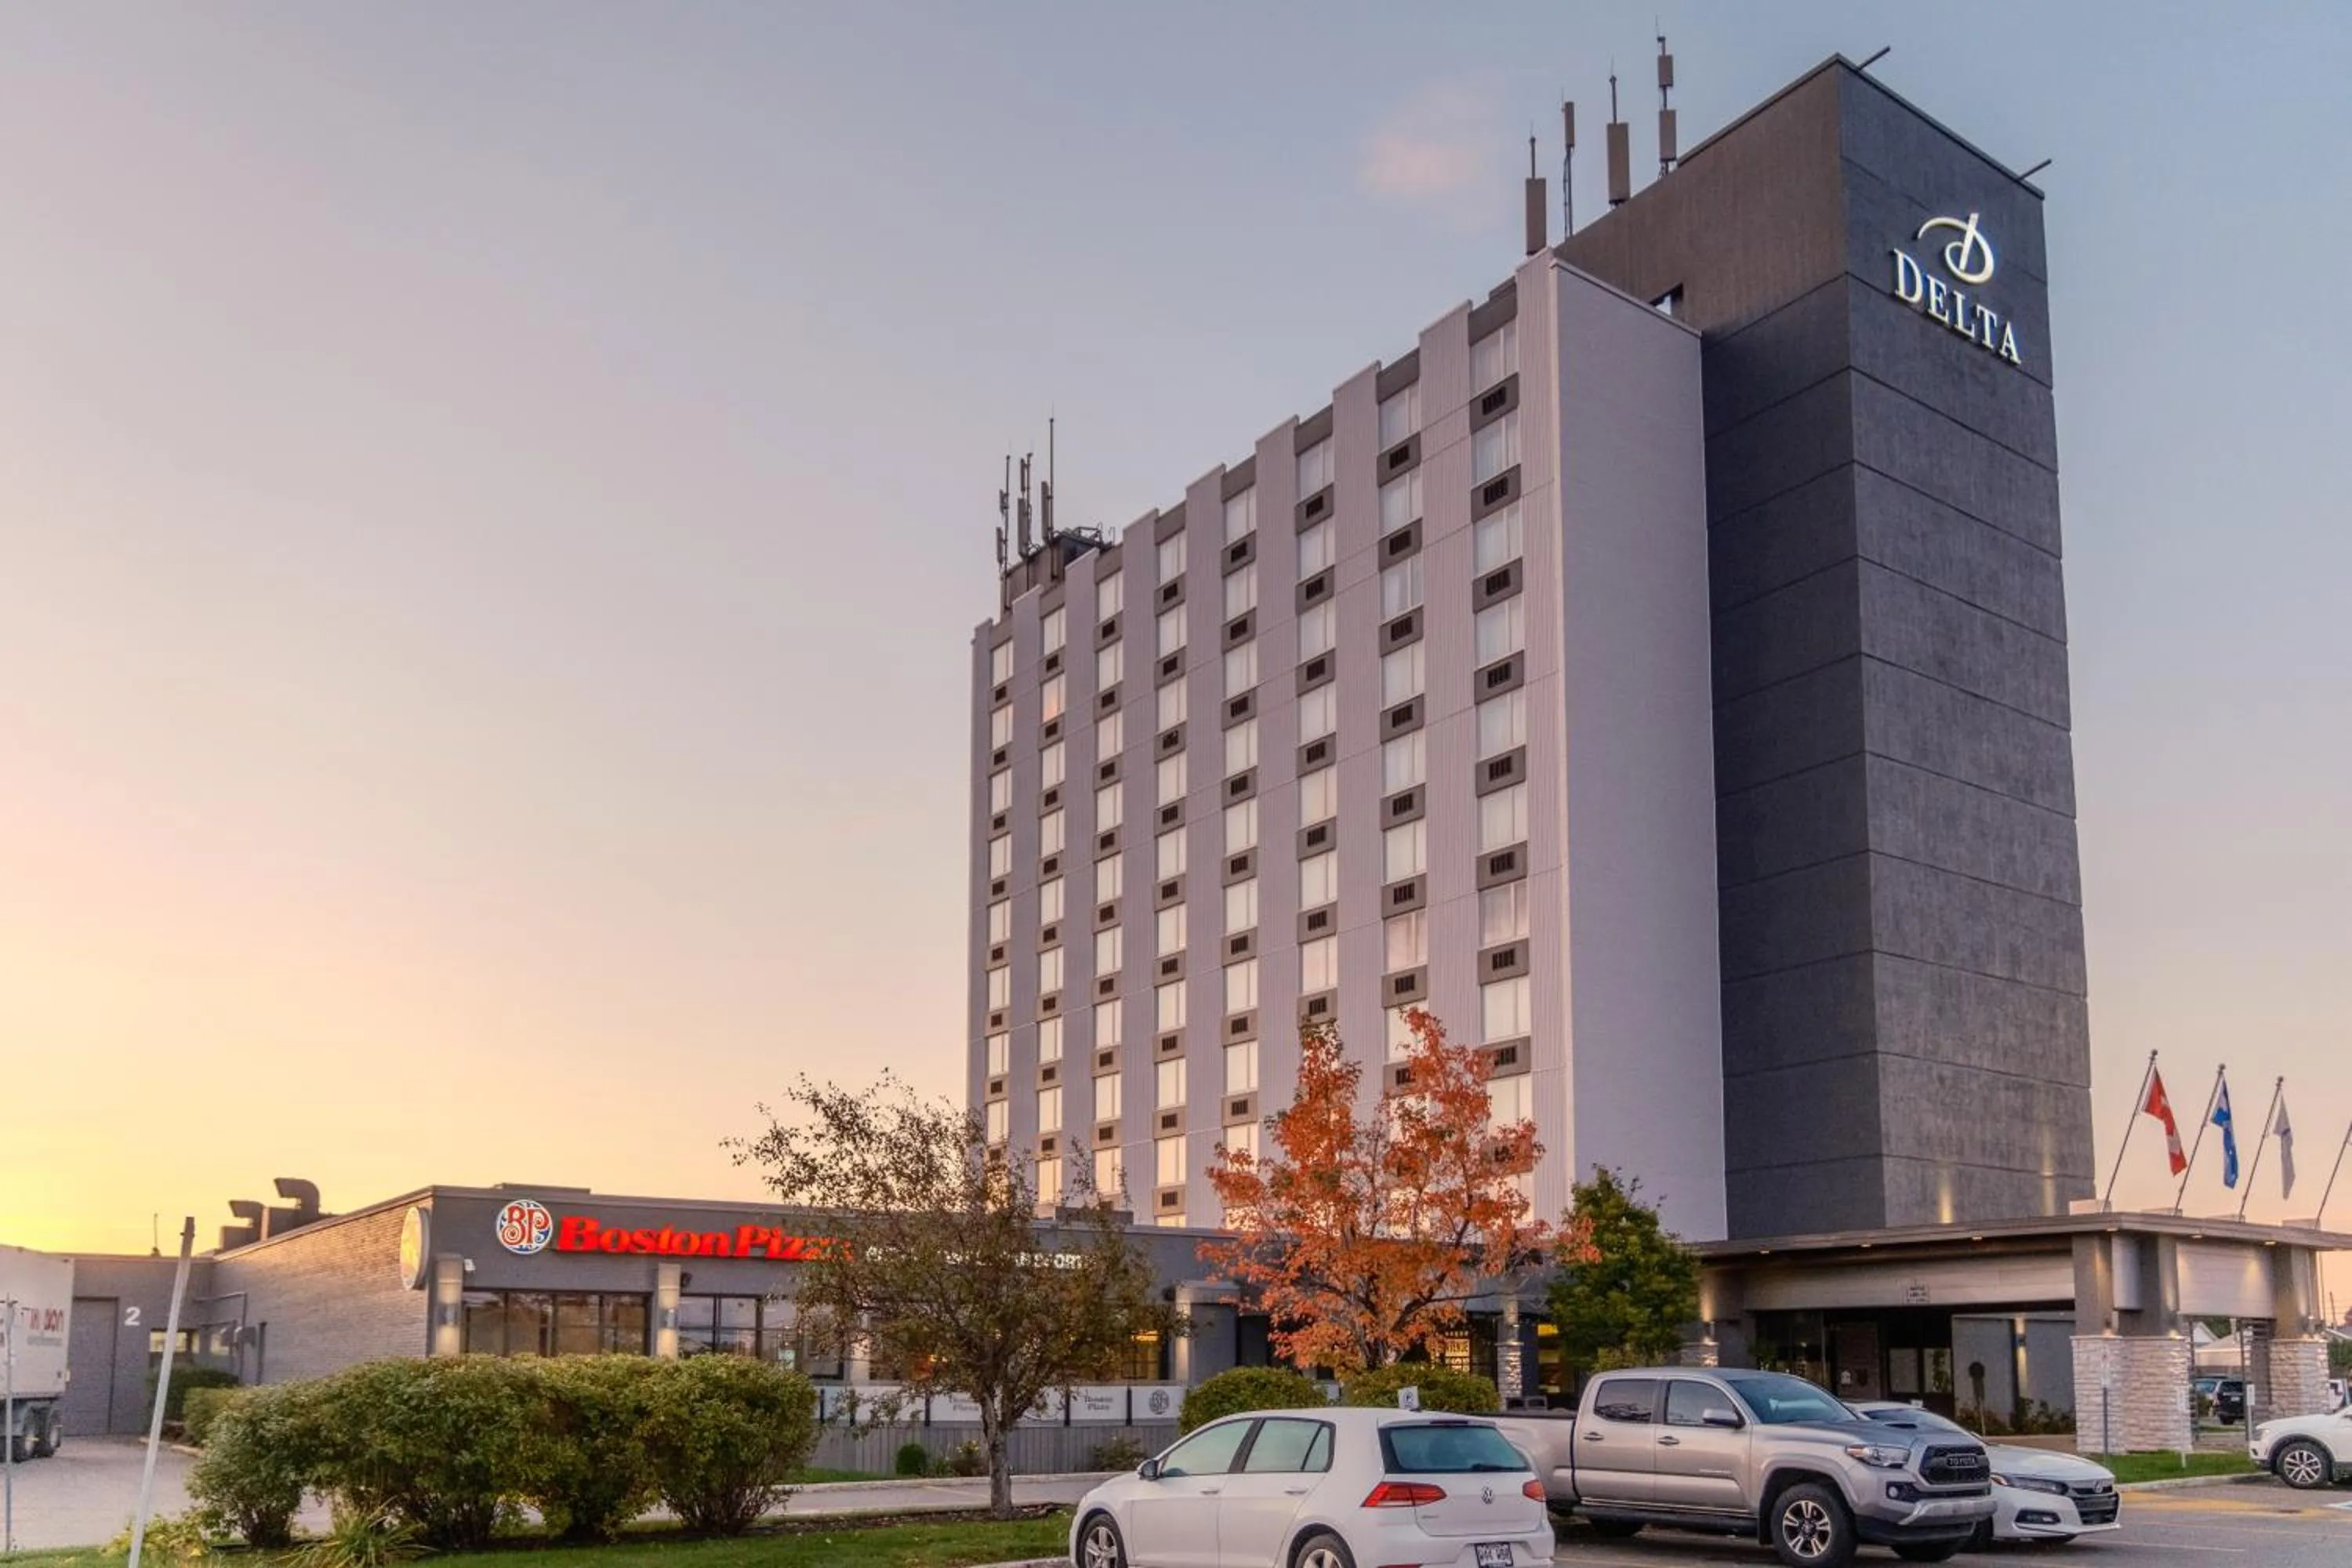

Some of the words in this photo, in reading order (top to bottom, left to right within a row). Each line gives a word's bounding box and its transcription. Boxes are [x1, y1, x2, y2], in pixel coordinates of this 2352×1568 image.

[1894, 248, 2021, 365] DELTA
[557, 1214, 732, 1256] Boston
[124, 1306, 141, 1327] 2
